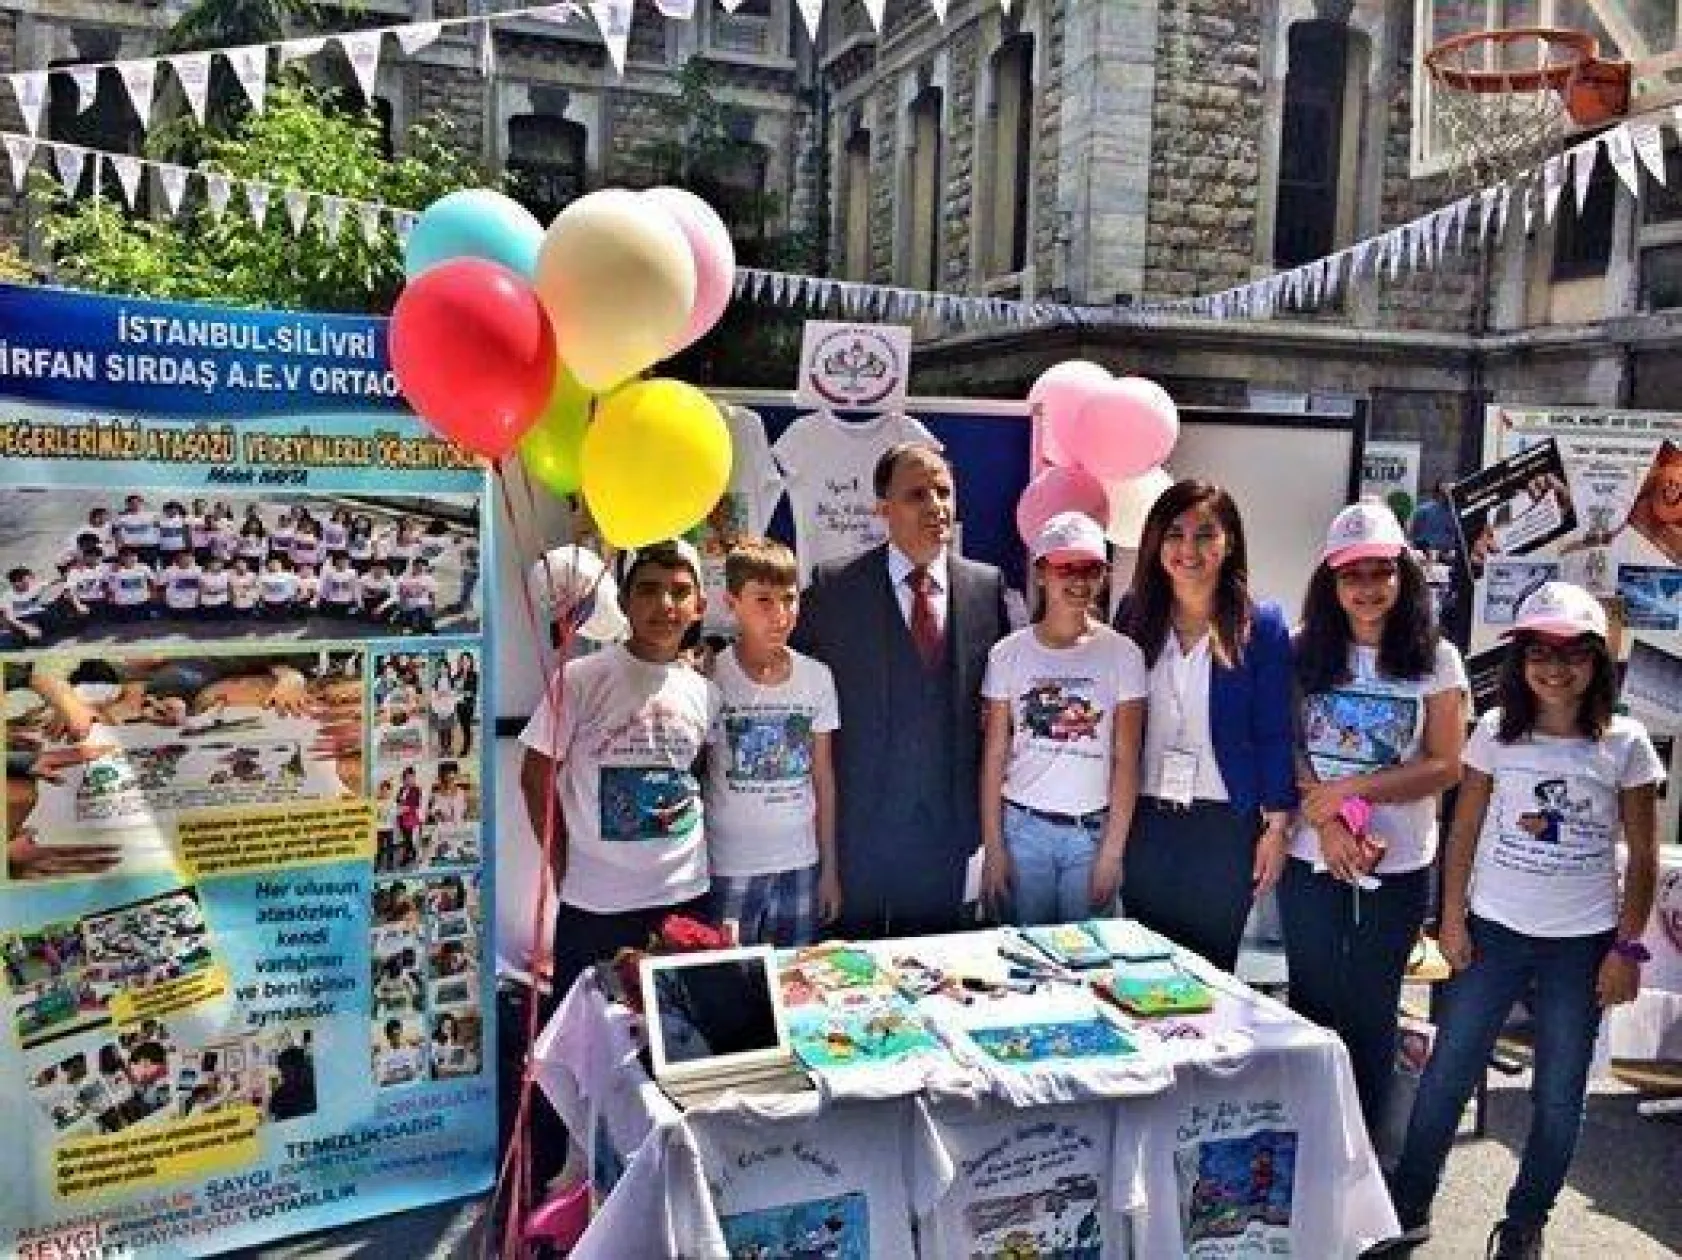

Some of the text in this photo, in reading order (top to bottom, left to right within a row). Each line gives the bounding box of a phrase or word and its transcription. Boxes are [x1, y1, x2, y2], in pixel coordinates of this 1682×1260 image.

[117, 309, 375, 360] İSTANBUL-SİLİVRİ
[0, 338, 97, 382] İRFAN
[105, 354, 218, 394] SIRDAŞ
[226, 360, 300, 391] A.E.V
